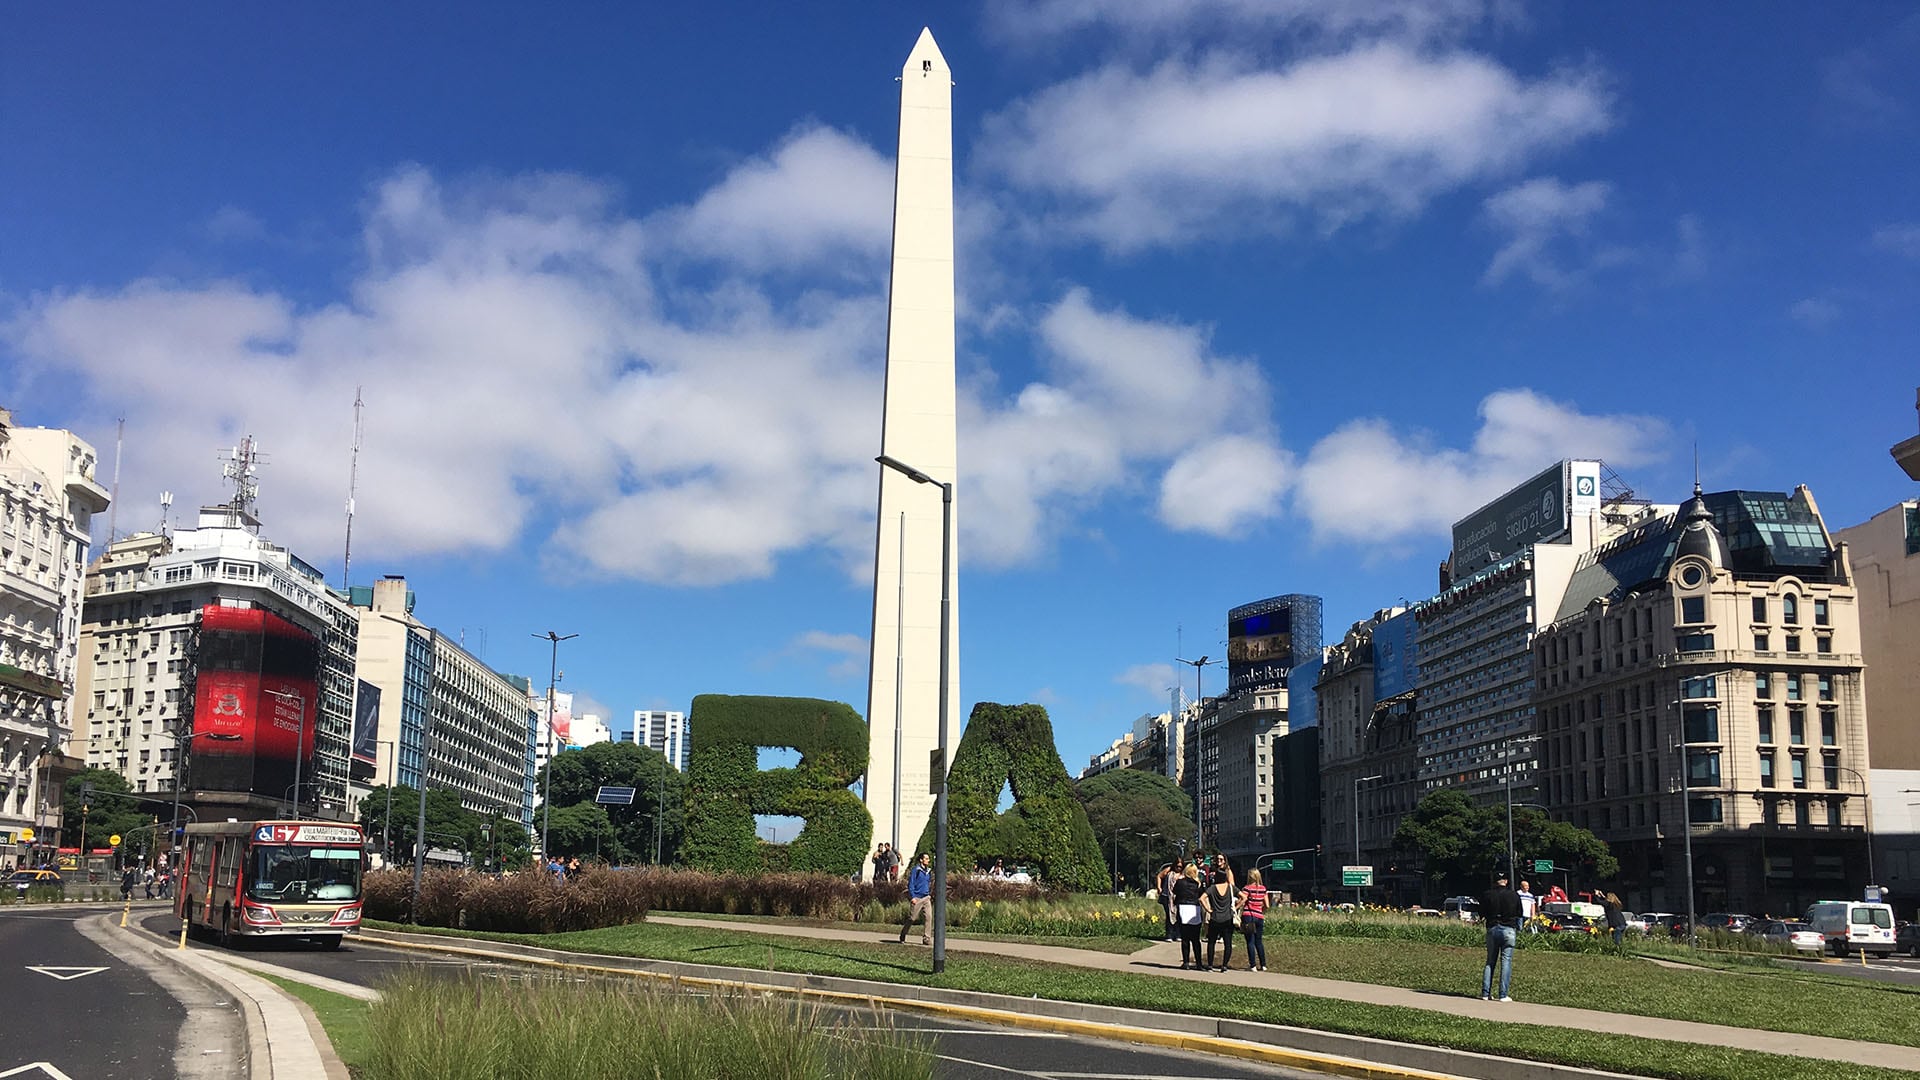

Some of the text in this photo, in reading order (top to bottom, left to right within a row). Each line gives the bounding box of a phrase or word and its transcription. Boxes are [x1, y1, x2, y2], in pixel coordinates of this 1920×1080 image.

[1458, 521, 1497, 552] La educación
[1506, 510, 1540, 541] SIGLO 21
[273, 825, 300, 842] 67
